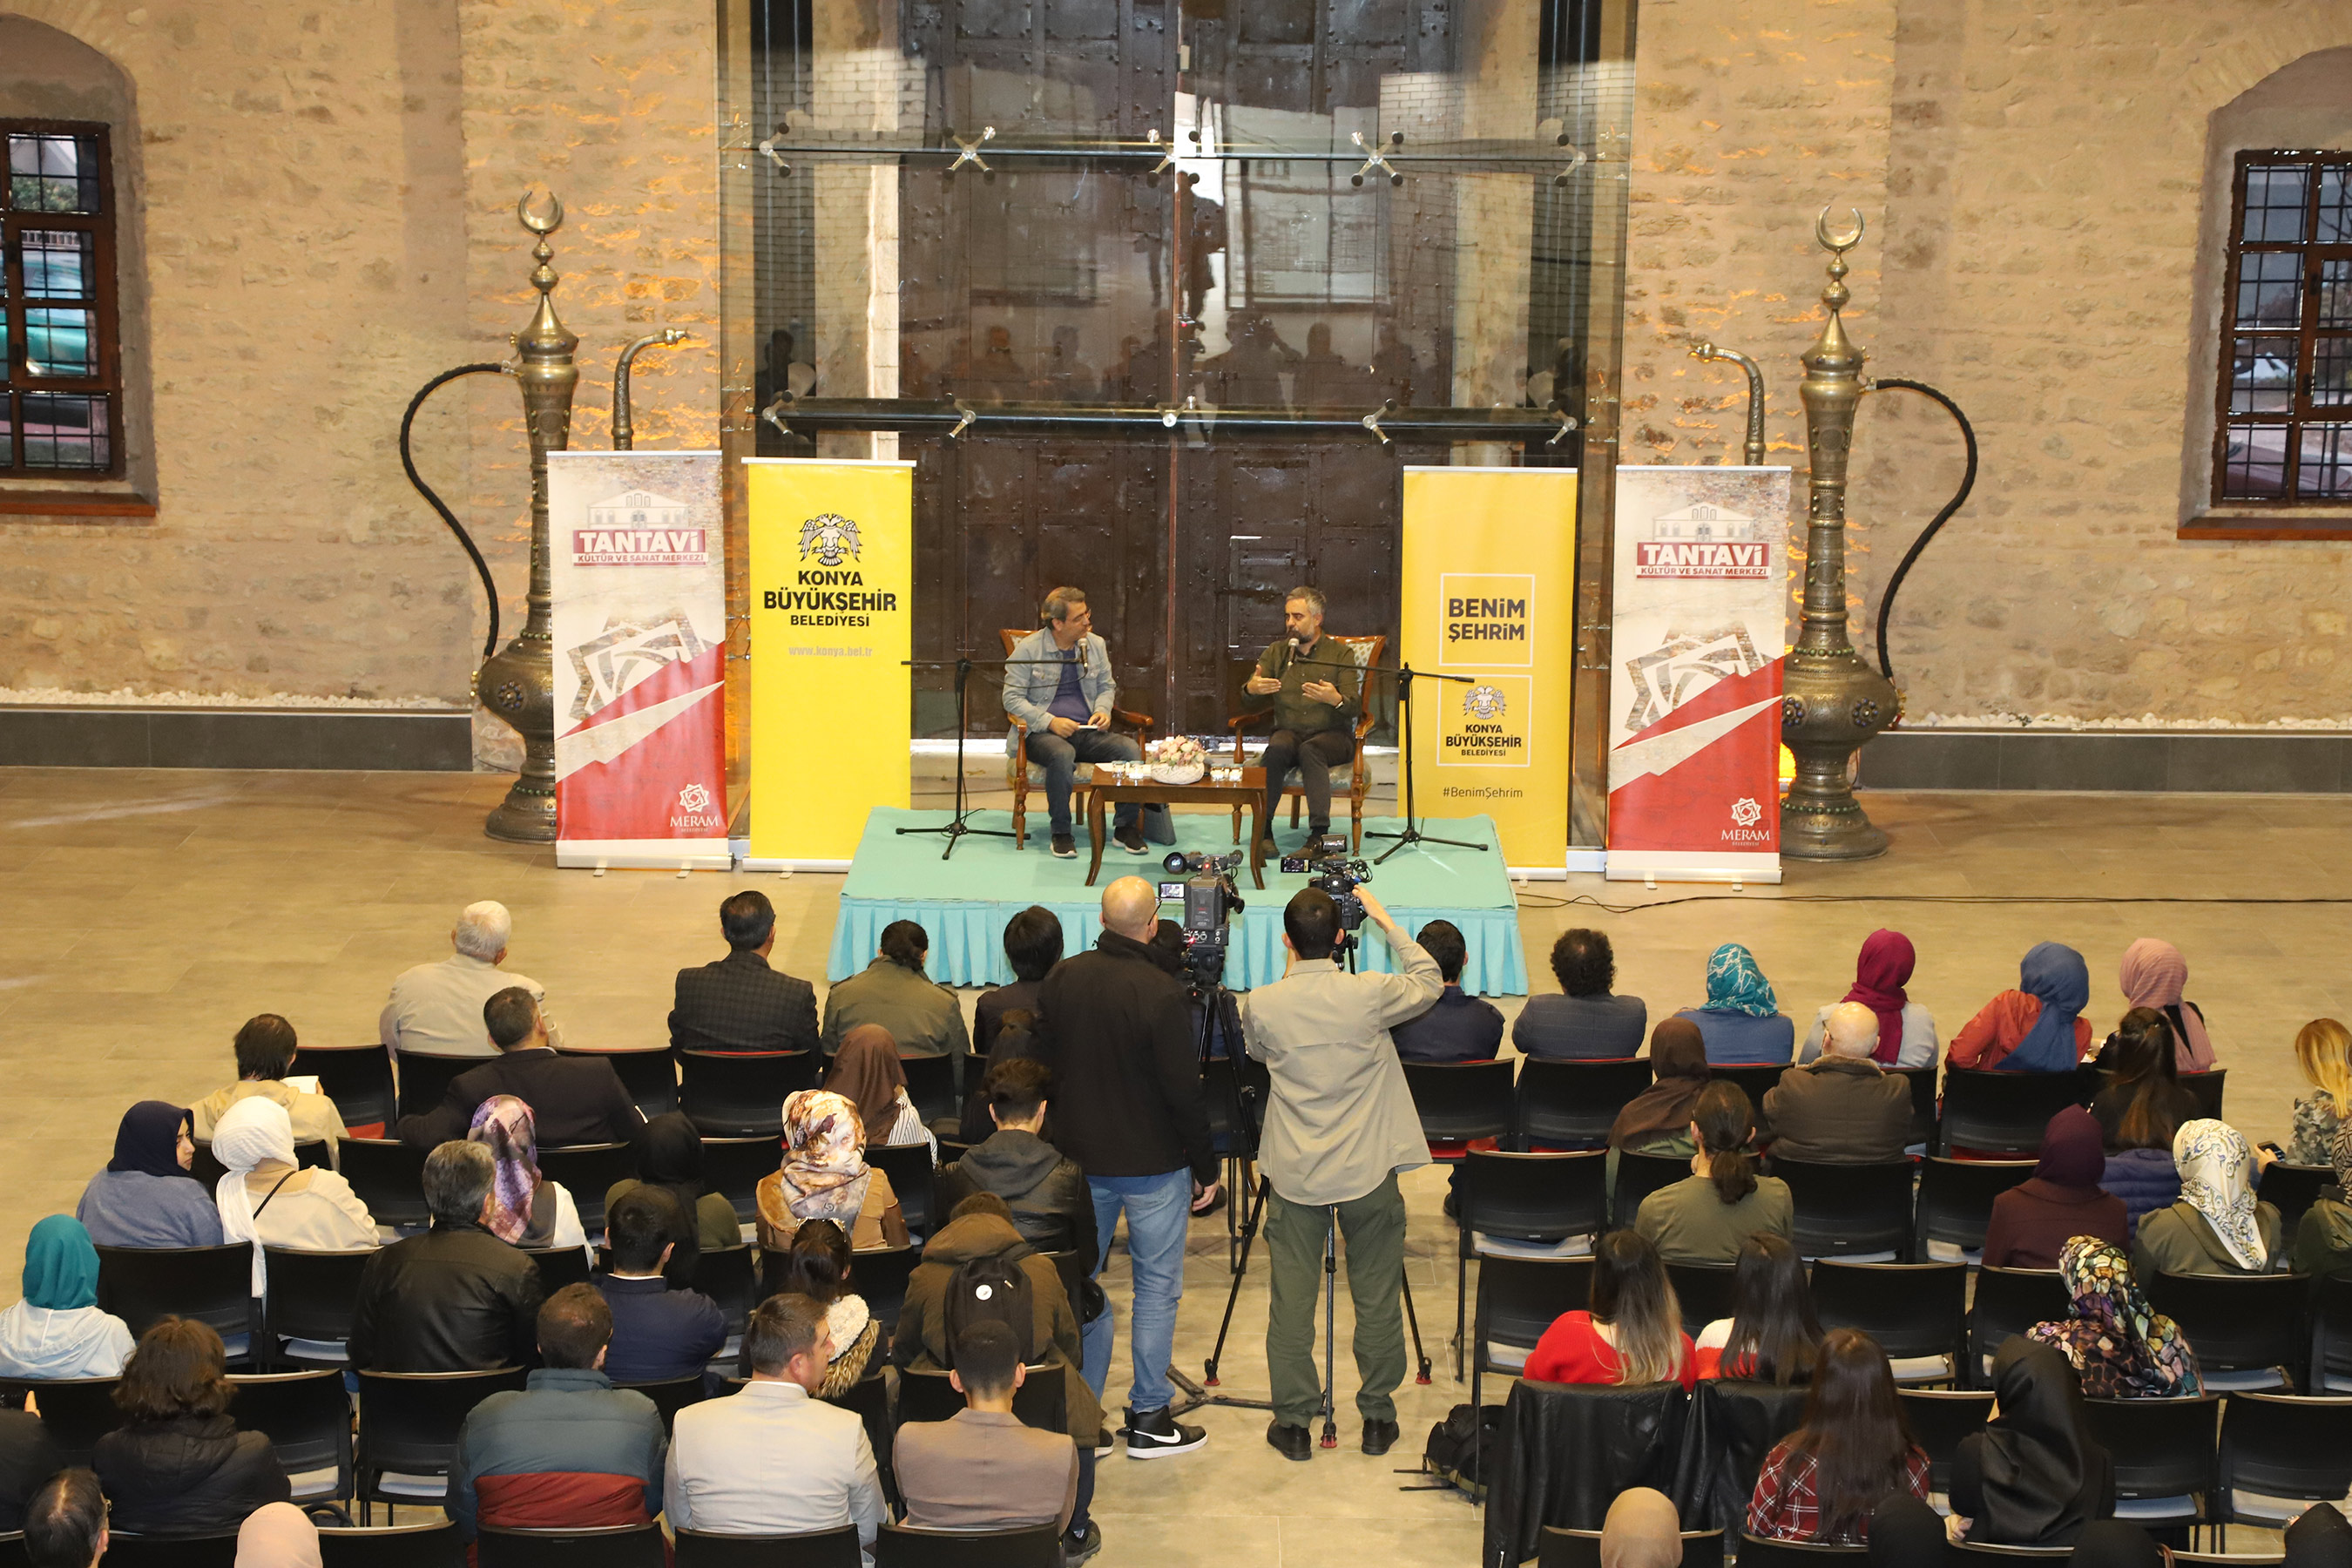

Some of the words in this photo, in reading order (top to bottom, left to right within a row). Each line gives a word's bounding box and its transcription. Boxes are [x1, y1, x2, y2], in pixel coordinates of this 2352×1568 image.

[578, 531, 699, 553] TANTAVİ
[578, 553, 614, 562] KÜLTÜR
[1643, 544, 1763, 566] TANTAVİ
[1640, 565, 1676, 575] KÜLTÜR
[798, 570, 863, 586] KONYA
[764, 587, 896, 613] BÜYÜKŞEHİR
[1449, 598, 1525, 618] BENİM
[790, 612, 869, 626] BELEDİYESİ
[1448, 623, 1524, 643] ŞEHRİM
[788, 645, 873, 658] www.konya.bel.tr
[1465, 724, 1504, 733] KONYA
[1446, 733, 1522, 748] BÜYÜKŞEHİR
[1443, 787, 1524, 800] #BenimŞehrim
[669, 815, 719, 828] MERAM
[1720, 829, 1770, 841] MERAM
